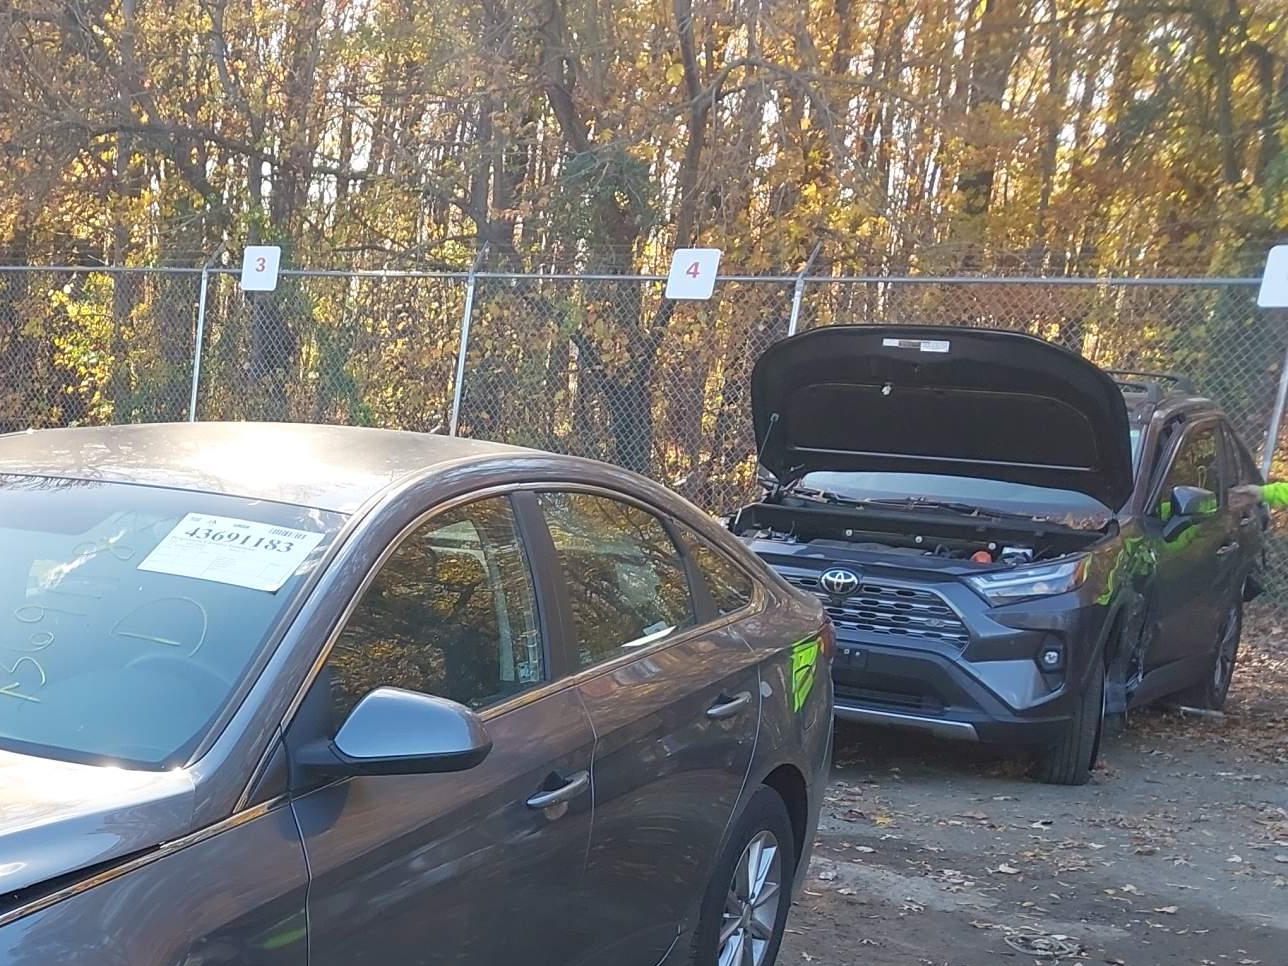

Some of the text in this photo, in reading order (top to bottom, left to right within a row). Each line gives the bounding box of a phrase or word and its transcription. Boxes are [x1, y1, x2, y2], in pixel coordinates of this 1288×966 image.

[255, 256, 267, 273] 3
[686, 261, 701, 279] 4
[184, 526, 294, 553] 43691183
